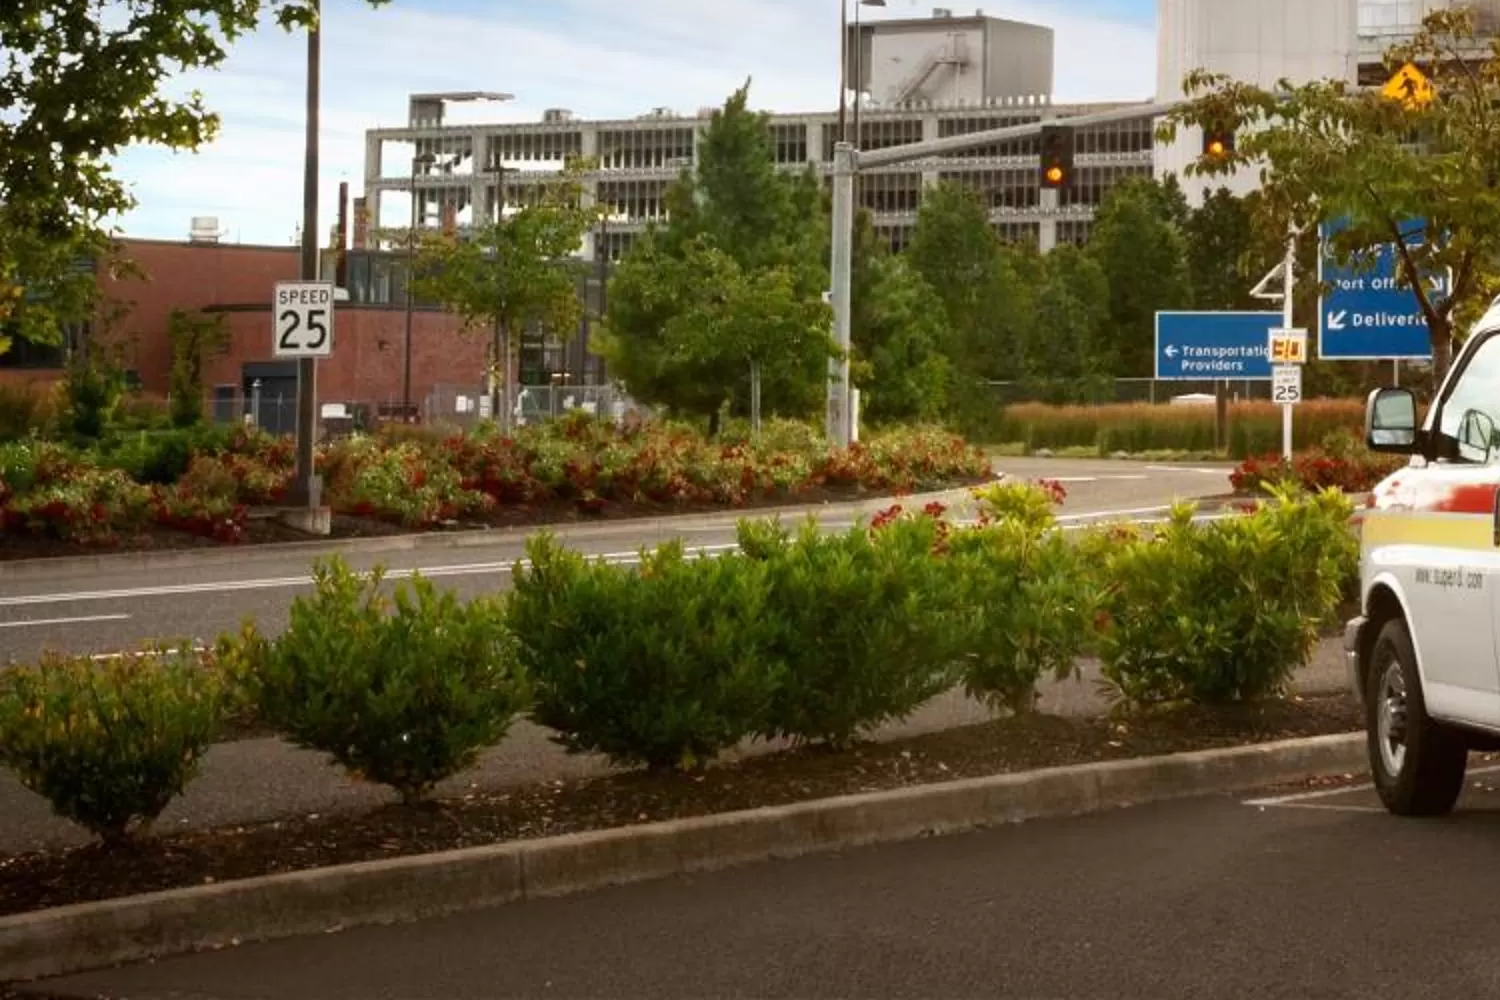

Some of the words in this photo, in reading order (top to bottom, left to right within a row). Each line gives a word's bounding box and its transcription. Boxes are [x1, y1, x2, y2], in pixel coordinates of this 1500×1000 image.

[1336, 278, 1364, 290] ort
[279, 289, 329, 305] SPEED
[1352, 312, 1430, 327] Deliverie
[279, 309, 327, 349] 25
[1181, 344, 1269, 359] Transportatio
[1181, 359, 1244, 372] Providers
[1275, 385, 1299, 400] 25
